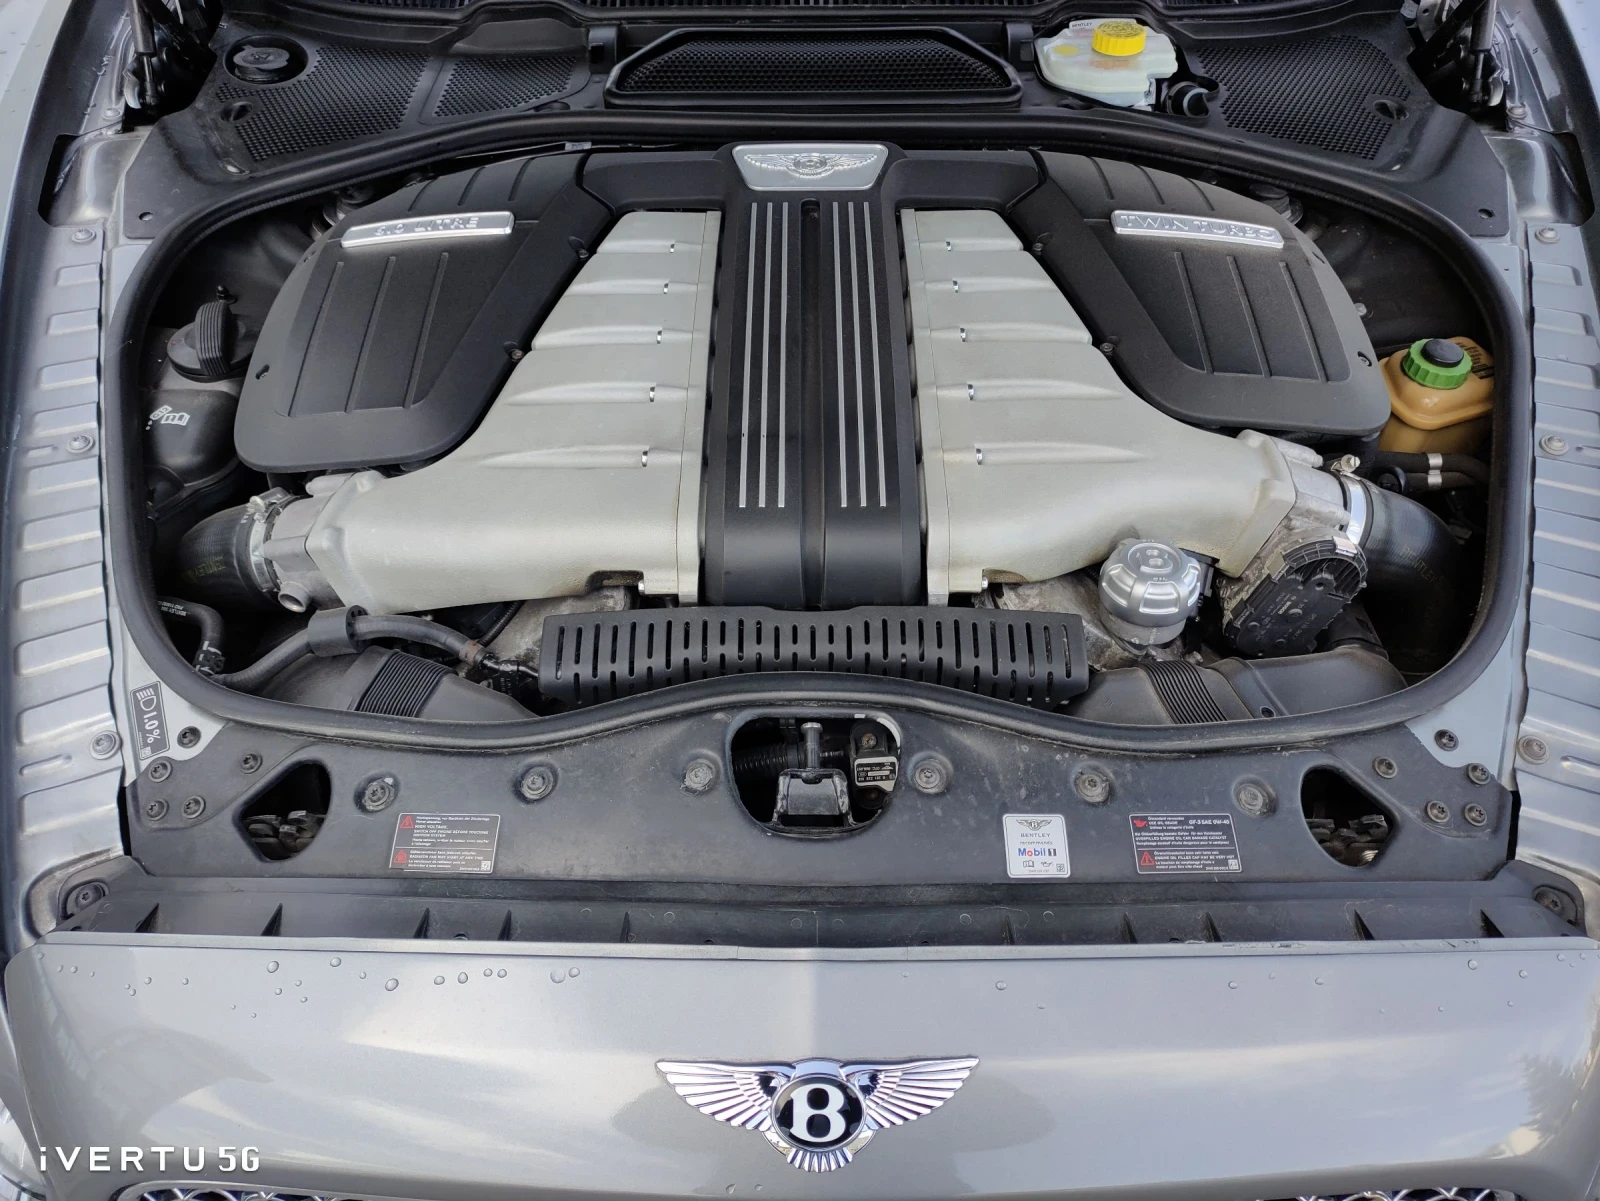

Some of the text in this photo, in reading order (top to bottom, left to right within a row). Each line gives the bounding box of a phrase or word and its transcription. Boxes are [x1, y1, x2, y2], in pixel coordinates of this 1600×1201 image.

[414, 217, 479, 232] LITRE
[1120, 215, 1275, 239] TWIN TURBO
[143, 711, 161, 743] 1.0%
[1018, 848, 1057, 857] Mobil 1
[790, 1083, 846, 1143] B
